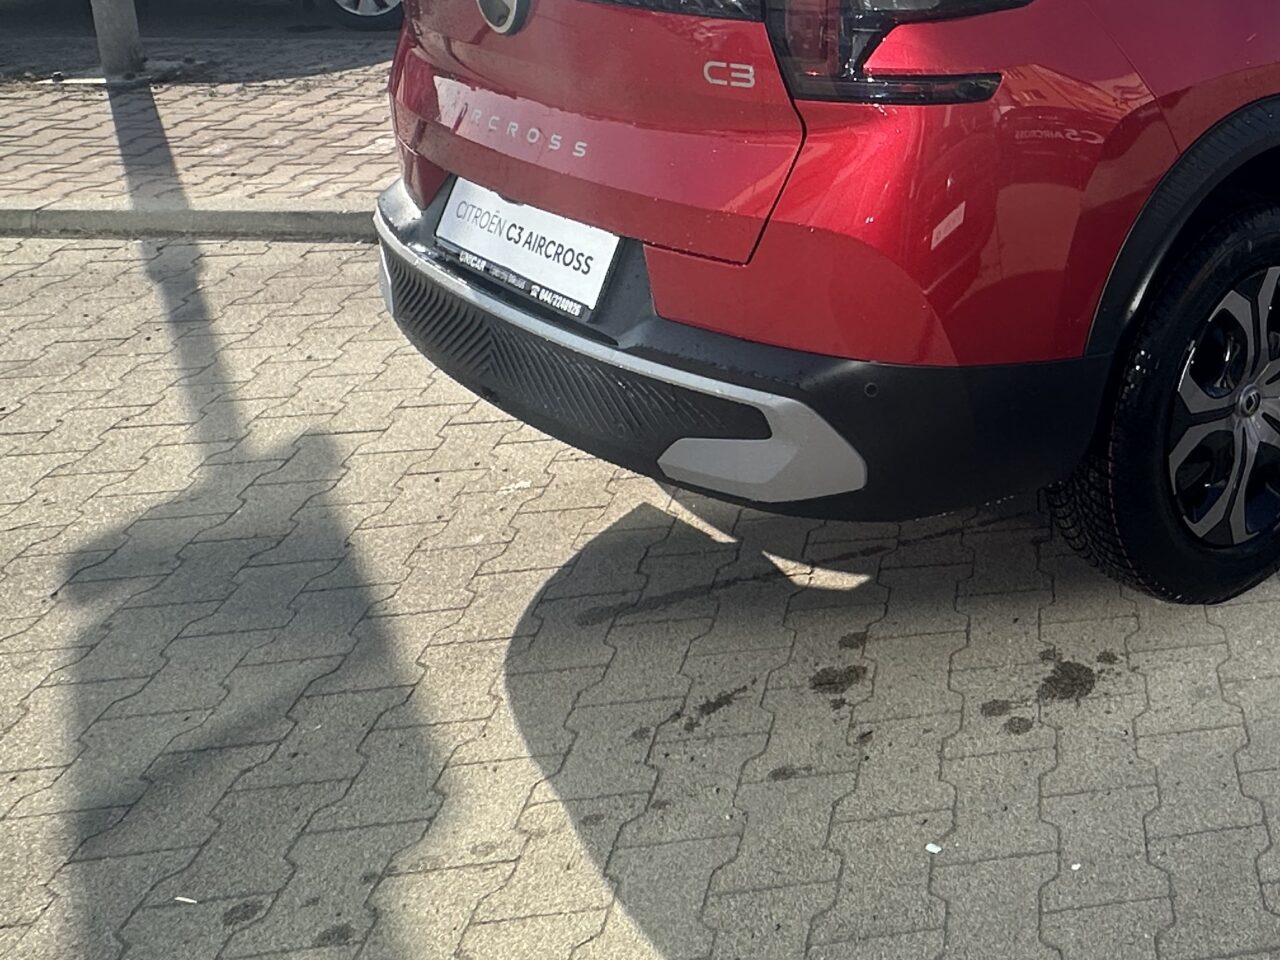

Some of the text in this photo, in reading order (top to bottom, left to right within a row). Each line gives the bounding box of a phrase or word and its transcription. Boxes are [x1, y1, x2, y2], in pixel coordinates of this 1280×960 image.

[704, 61, 755, 88] C3
[456, 200, 594, 275] CITROËN C3 AIRCROSS
